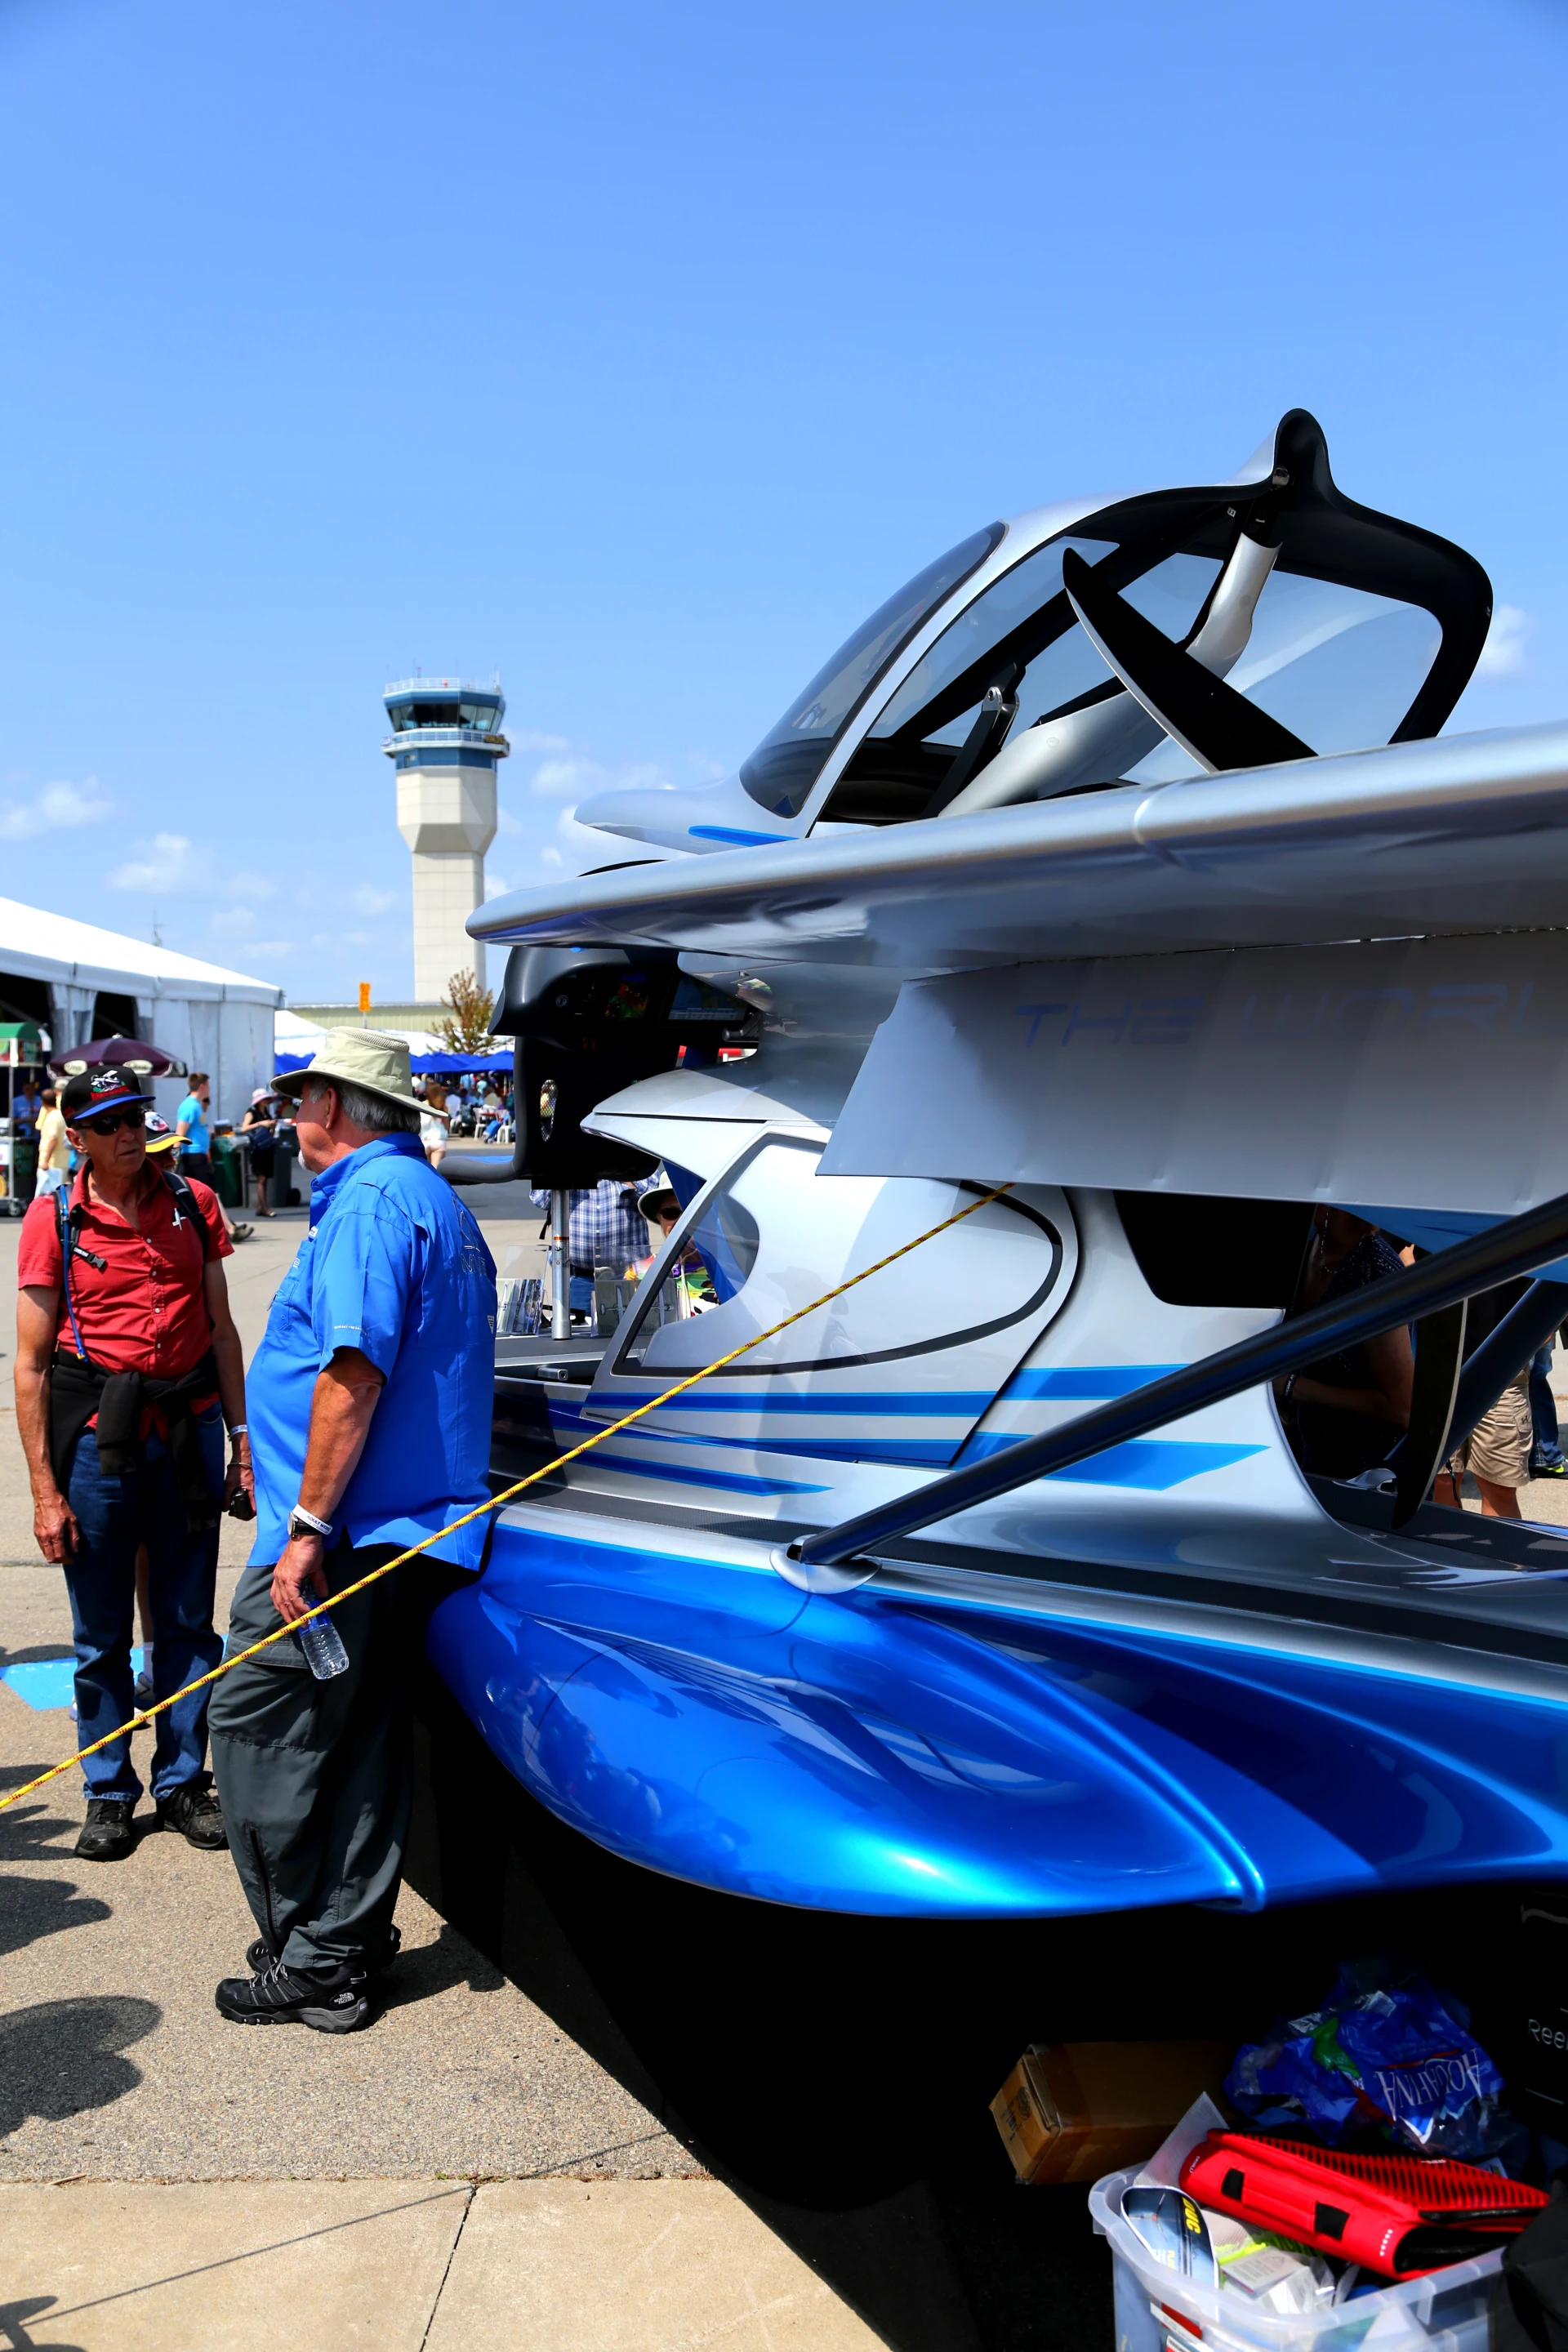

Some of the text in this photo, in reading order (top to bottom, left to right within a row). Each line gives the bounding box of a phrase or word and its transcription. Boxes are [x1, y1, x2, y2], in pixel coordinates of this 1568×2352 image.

[1016, 996, 1203, 1048] THE
[1528, 2018, 1568, 2051] Ree
[1374, 2048, 1482, 2122] AQUAFINA
